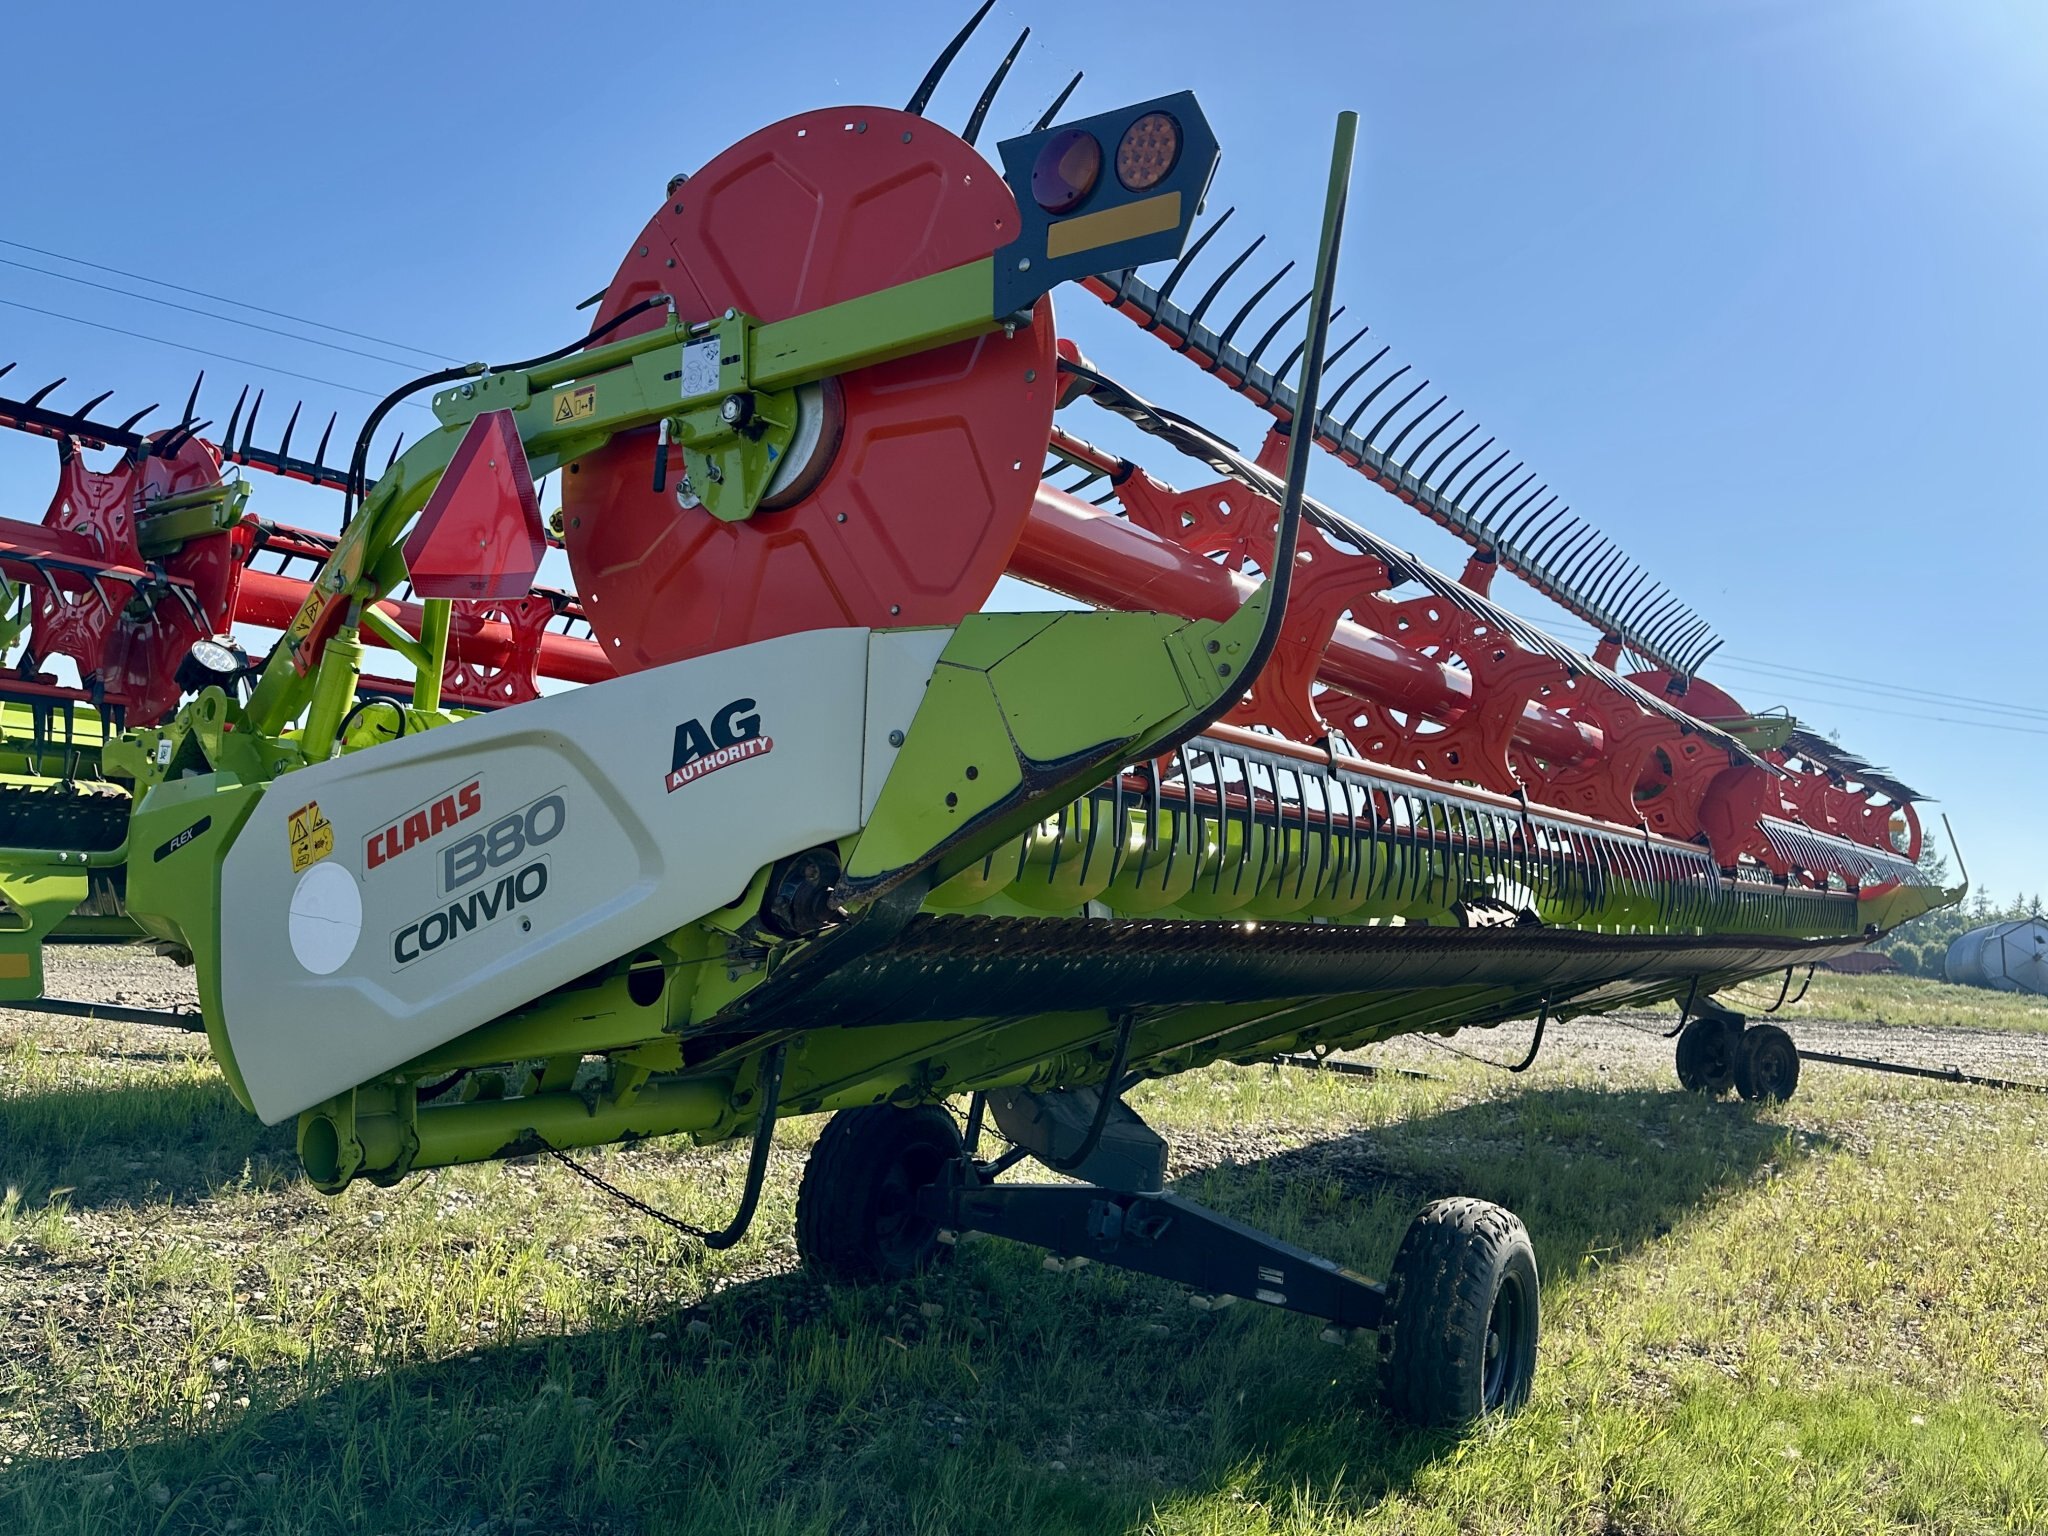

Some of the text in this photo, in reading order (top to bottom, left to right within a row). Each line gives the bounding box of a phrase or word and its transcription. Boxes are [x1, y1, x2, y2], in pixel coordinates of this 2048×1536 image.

[671, 698, 761, 773] AG
[672, 737, 769, 787] AUTHORITY
[170, 827, 193, 852] FLEX
[367, 781, 481, 869] CLAAS
[394, 862, 548, 964] CONVIO
